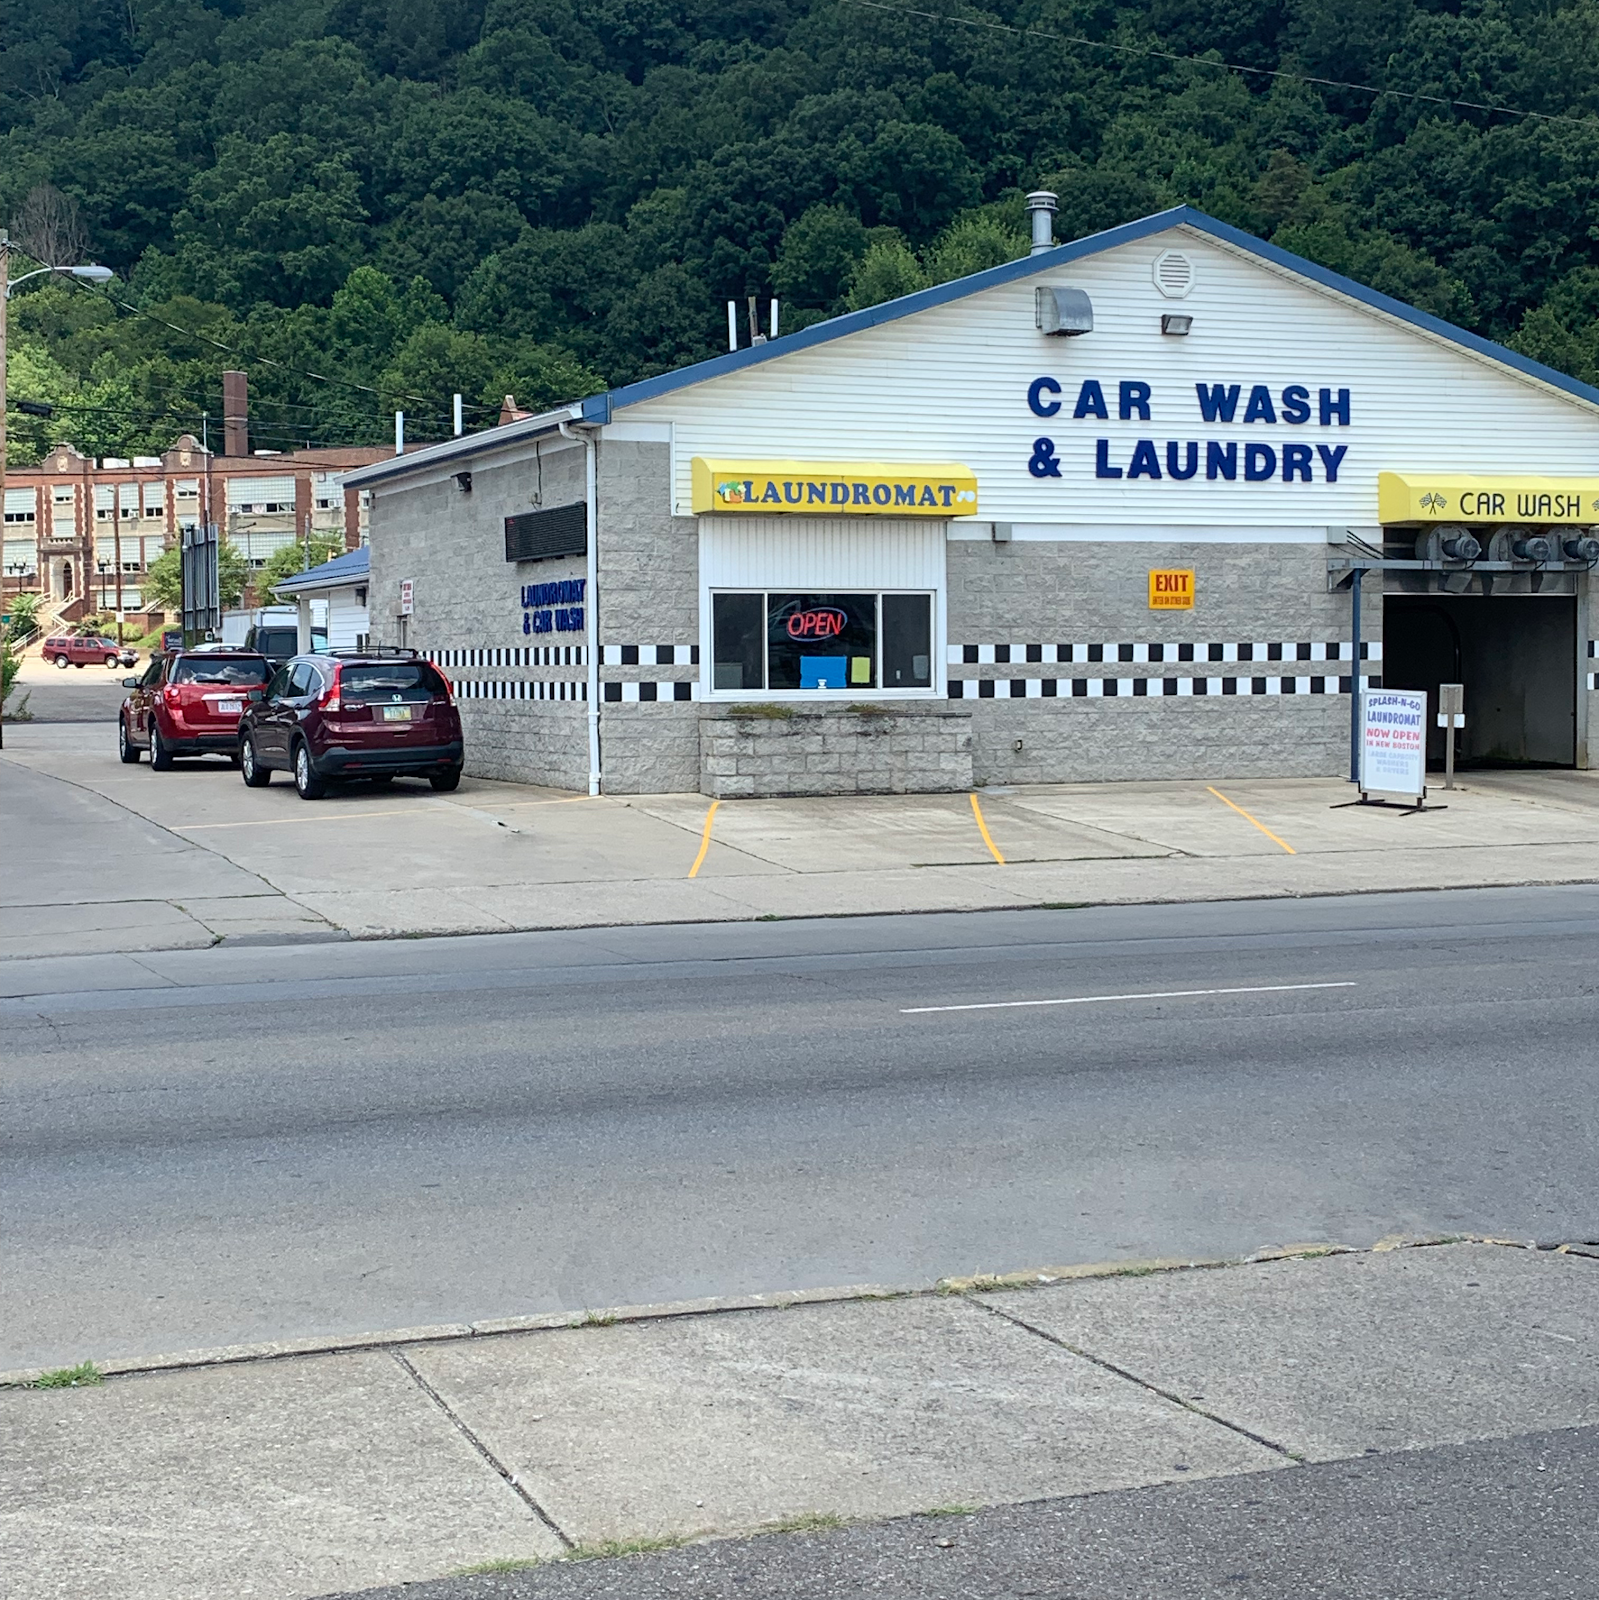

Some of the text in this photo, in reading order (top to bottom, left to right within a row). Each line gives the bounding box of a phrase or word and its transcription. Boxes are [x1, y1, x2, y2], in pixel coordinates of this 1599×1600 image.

[1027, 376, 1350, 426] CAR WASH
[1027, 437, 1349, 482] & LAUNDRY
[742, 480, 956, 507] LAUNDROMAT
[1460, 492, 1580, 517] CAR WASH
[521, 578, 586, 608] LAUNDROMAT
[1155, 574, 1188, 592] EXIT
[523, 607, 584, 635] & CAR WASH
[787, 612, 842, 636] OPEN
[1368, 696, 1421, 711] SPLASH-N-GO
[1367, 710, 1421, 726] LAUNDROMAT
[1366, 728, 1420, 741] NOW OPEN
[1366, 739, 1420, 750] IN NEW BOSTON
